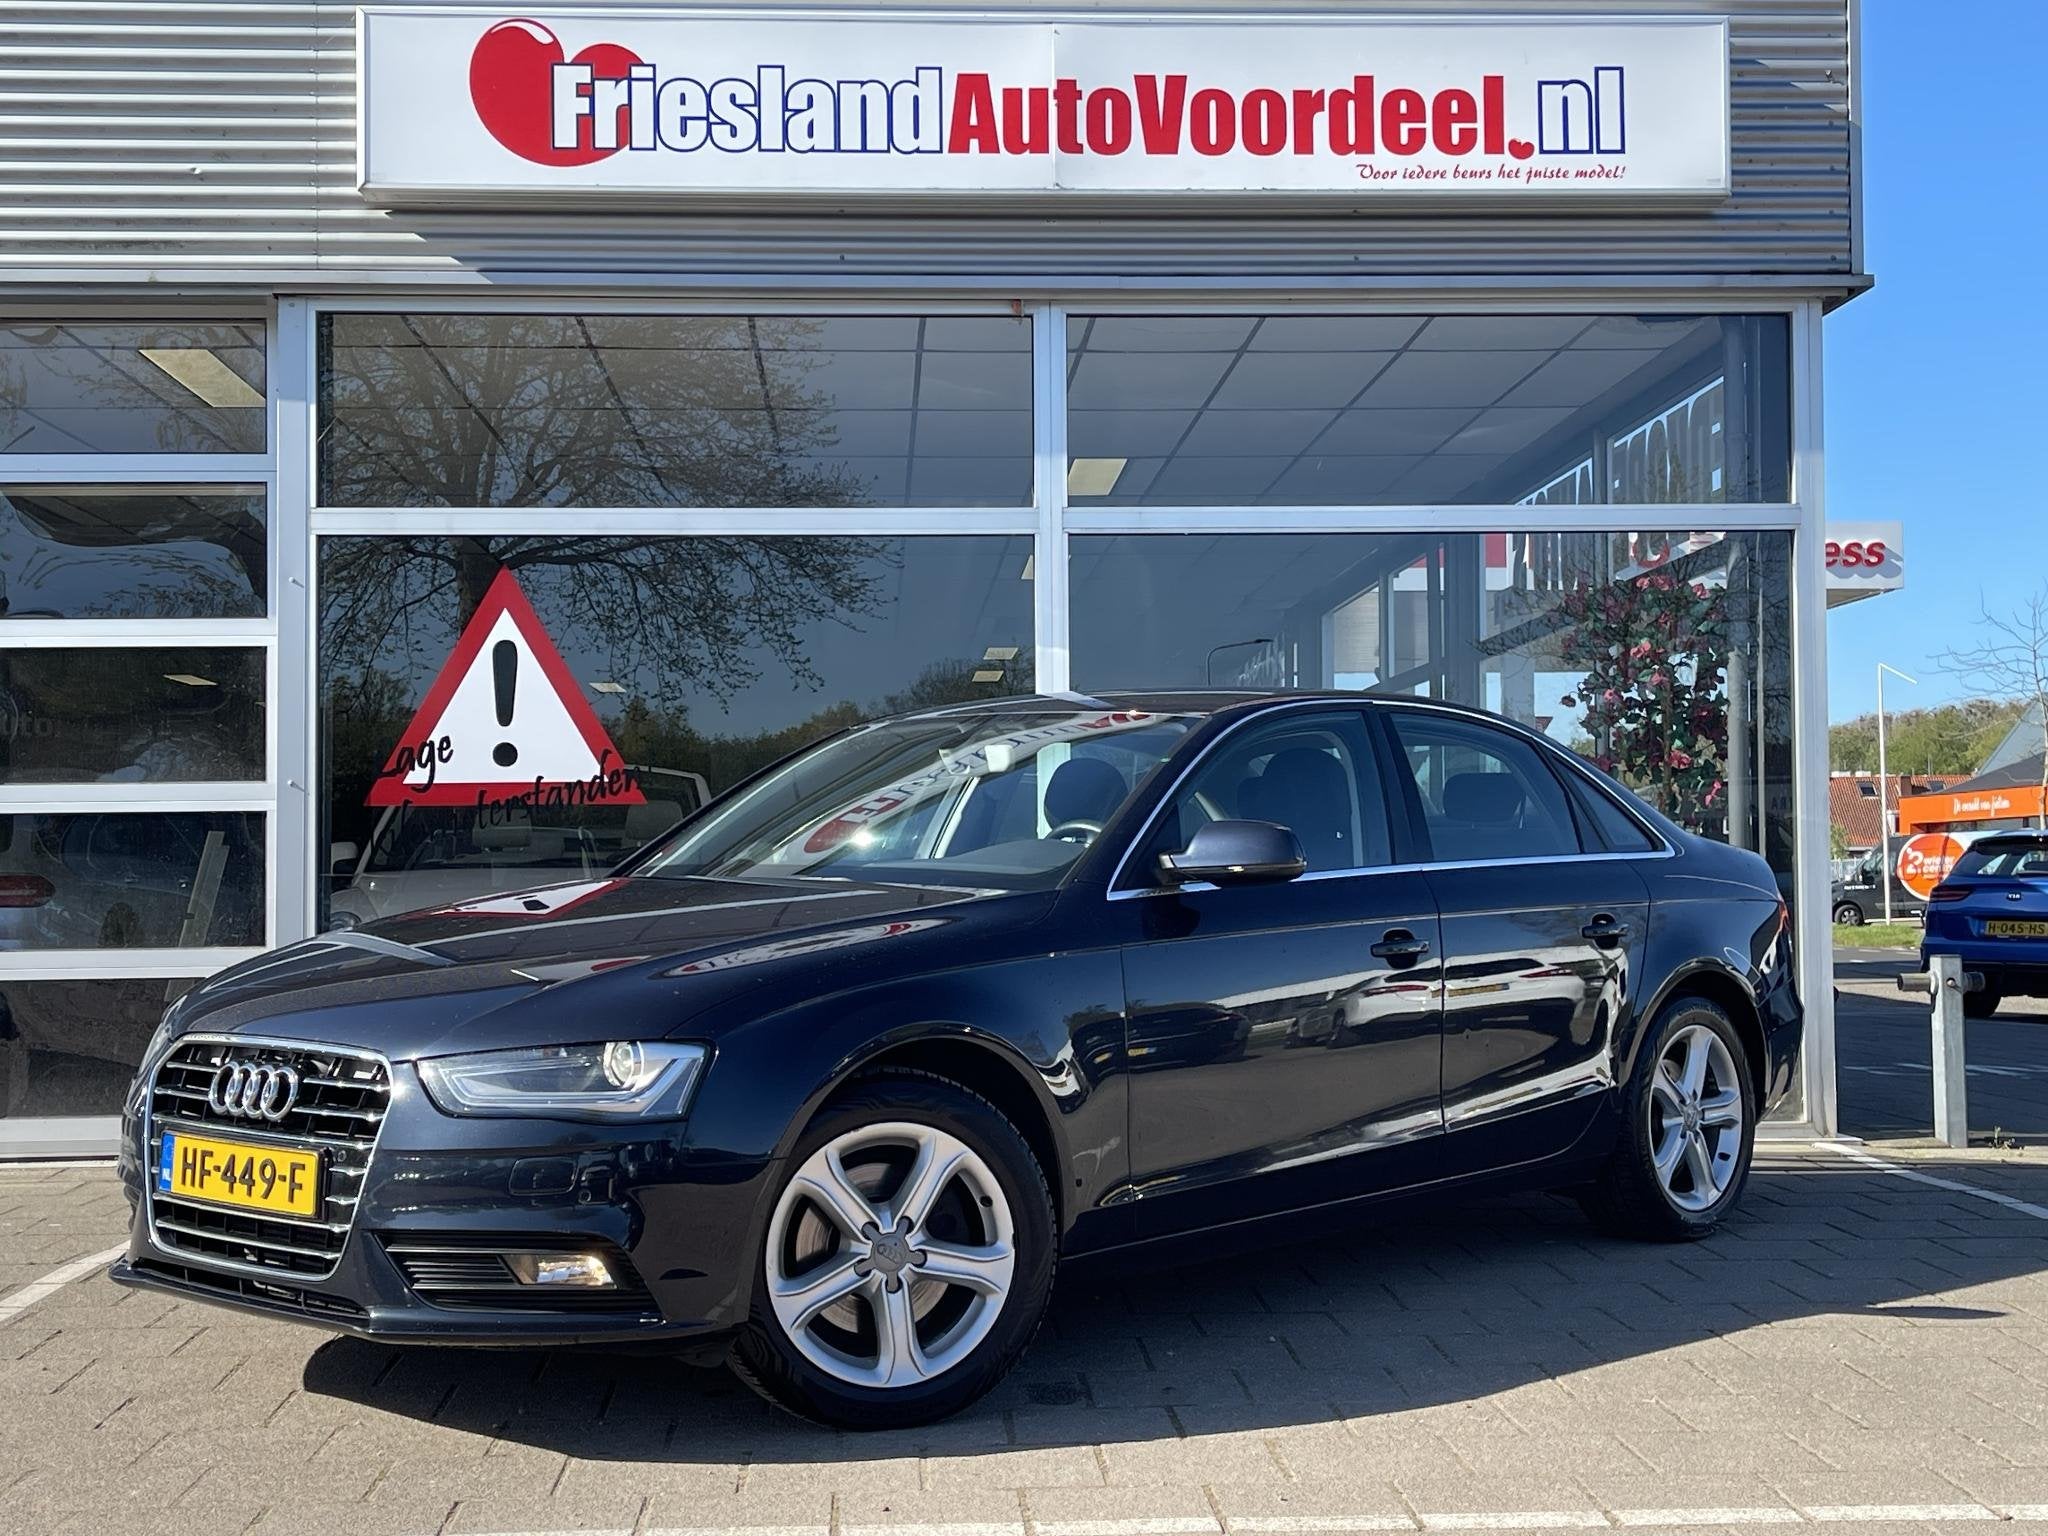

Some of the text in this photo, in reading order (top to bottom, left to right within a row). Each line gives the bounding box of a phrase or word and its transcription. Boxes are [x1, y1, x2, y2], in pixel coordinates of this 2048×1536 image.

[551, 64, 1626, 159] FrieslandAutoVoordeel.nl
[1356, 163, 1626, 184] Voor iedere beurs het juiste model!
[180, 1146, 306, 1203] HF-449-F
